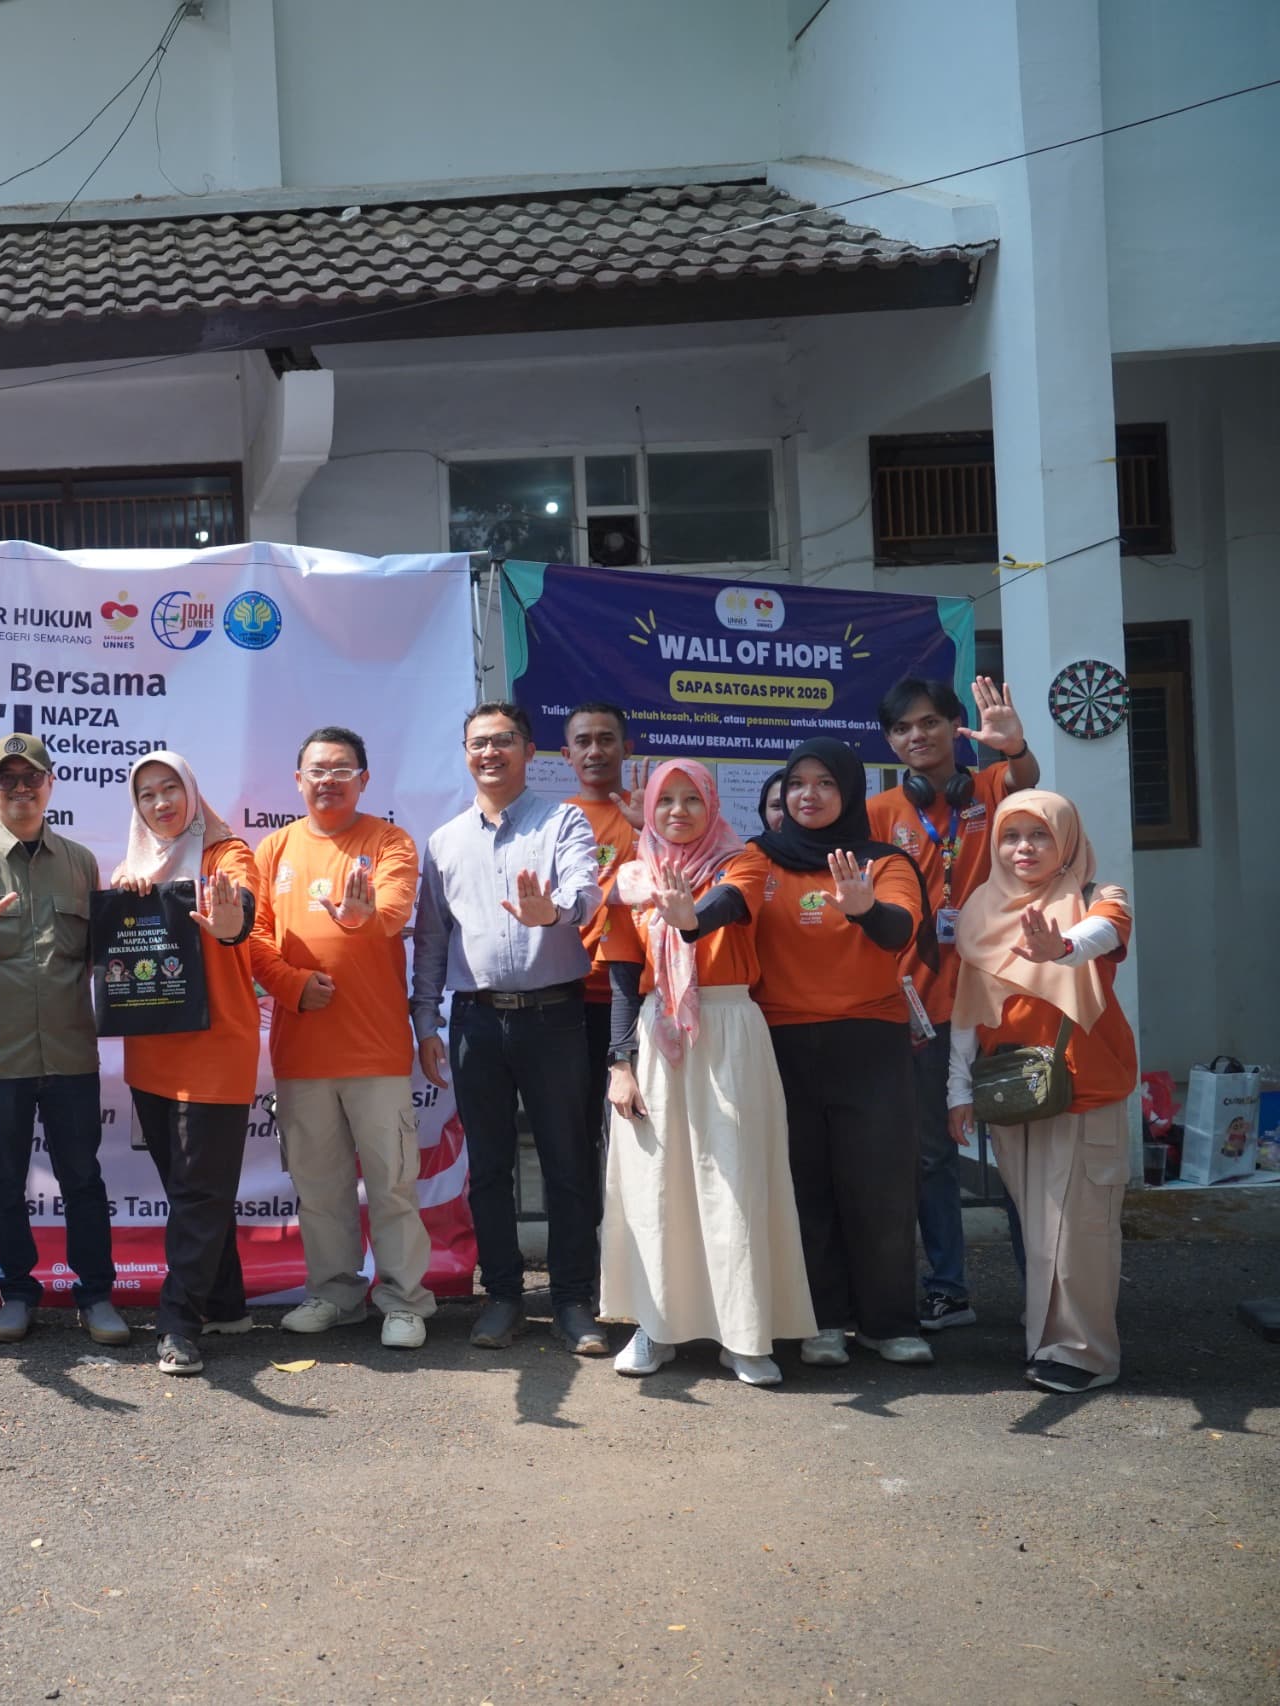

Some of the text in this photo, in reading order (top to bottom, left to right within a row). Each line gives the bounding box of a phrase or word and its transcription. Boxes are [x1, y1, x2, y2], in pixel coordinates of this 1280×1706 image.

[14, 608, 92, 628] HUKUM
[181, 603, 214, 630] JDIH
[33, 634, 92, 645] SEMARANG
[102, 641, 135, 649] UNNES
[657, 634, 843, 670] WALL OF HOPE
[10, 662, 166, 696] Bersama
[676, 680, 828, 700] SAPA SATGAS PPK 2026
[41, 705, 120, 728] NAPZA
[541, 704, 571, 716] Tulisk
[694, 712, 722, 724] kritik,
[723, 715, 746, 724] atau
[790, 718, 817, 728] untuk
[818, 719, 847, 729] UNNES
[848, 720, 865, 729] dan
[40, 733, 168, 755] Kekerasan
[649, 732, 705, 746] SUARAMU
[706, 736, 754, 748] BERARTI.
[755, 737, 784, 749] KAMI
[51, 761, 134, 788] orupsi
